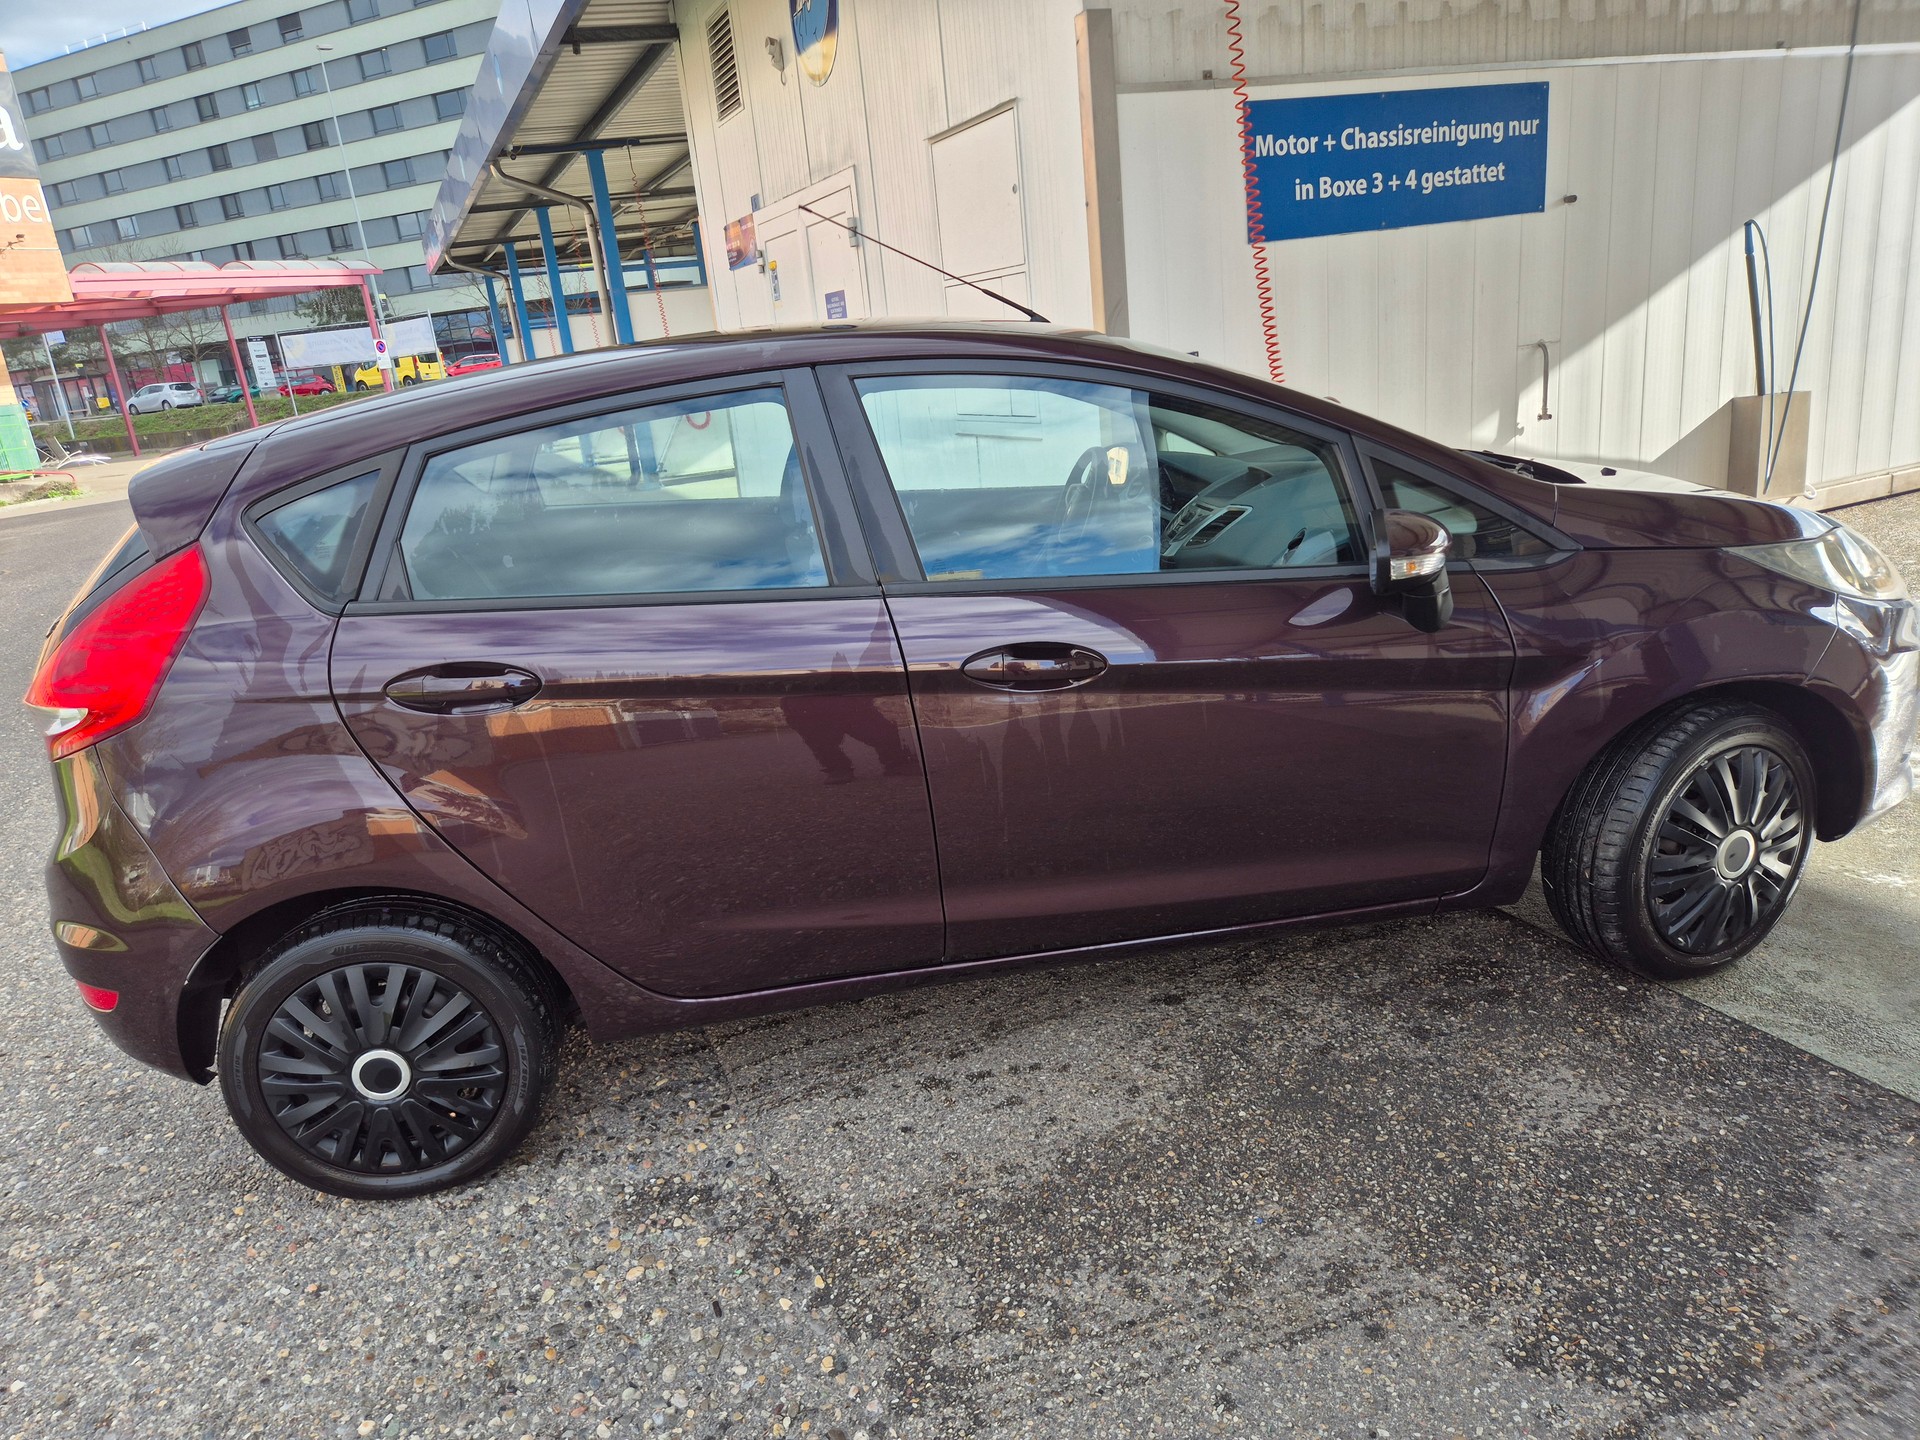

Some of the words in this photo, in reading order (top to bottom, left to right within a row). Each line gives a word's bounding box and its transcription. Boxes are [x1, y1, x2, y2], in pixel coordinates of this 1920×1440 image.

[1255, 134, 1319, 158] Motor
[1323, 134, 1336, 152] +
[1340, 119, 1504, 151] Chassisreinigung
[1508, 119, 1540, 136] nur
[1295, 178, 1314, 200] in
[1319, 176, 1368, 199] Boxe
[1371, 172, 1383, 194] 3
[1388, 174, 1401, 192] +
[1405, 169, 1417, 190] 4
[1421, 162, 1505, 194] gestattet
